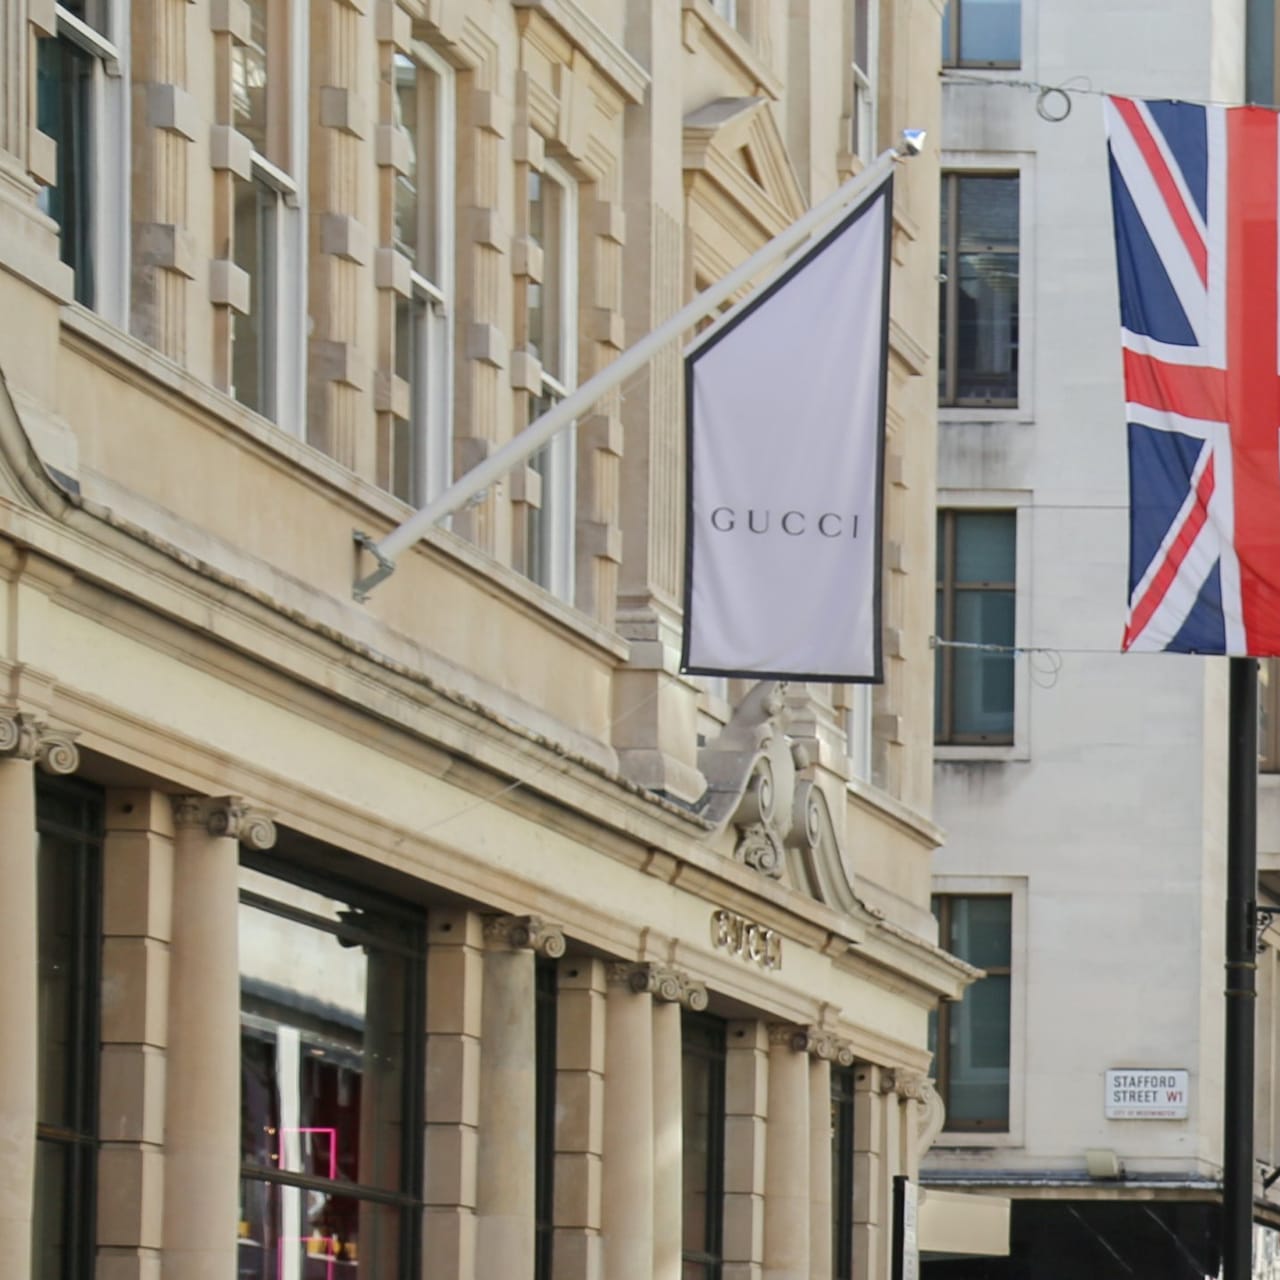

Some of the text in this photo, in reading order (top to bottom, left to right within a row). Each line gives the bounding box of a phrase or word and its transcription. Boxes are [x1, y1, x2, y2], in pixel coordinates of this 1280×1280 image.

[710, 506, 859, 539] GUCCI
[1113, 1075, 1176, 1088] STAFFORD
[1113, 1090, 1183, 1103] STREET W1
